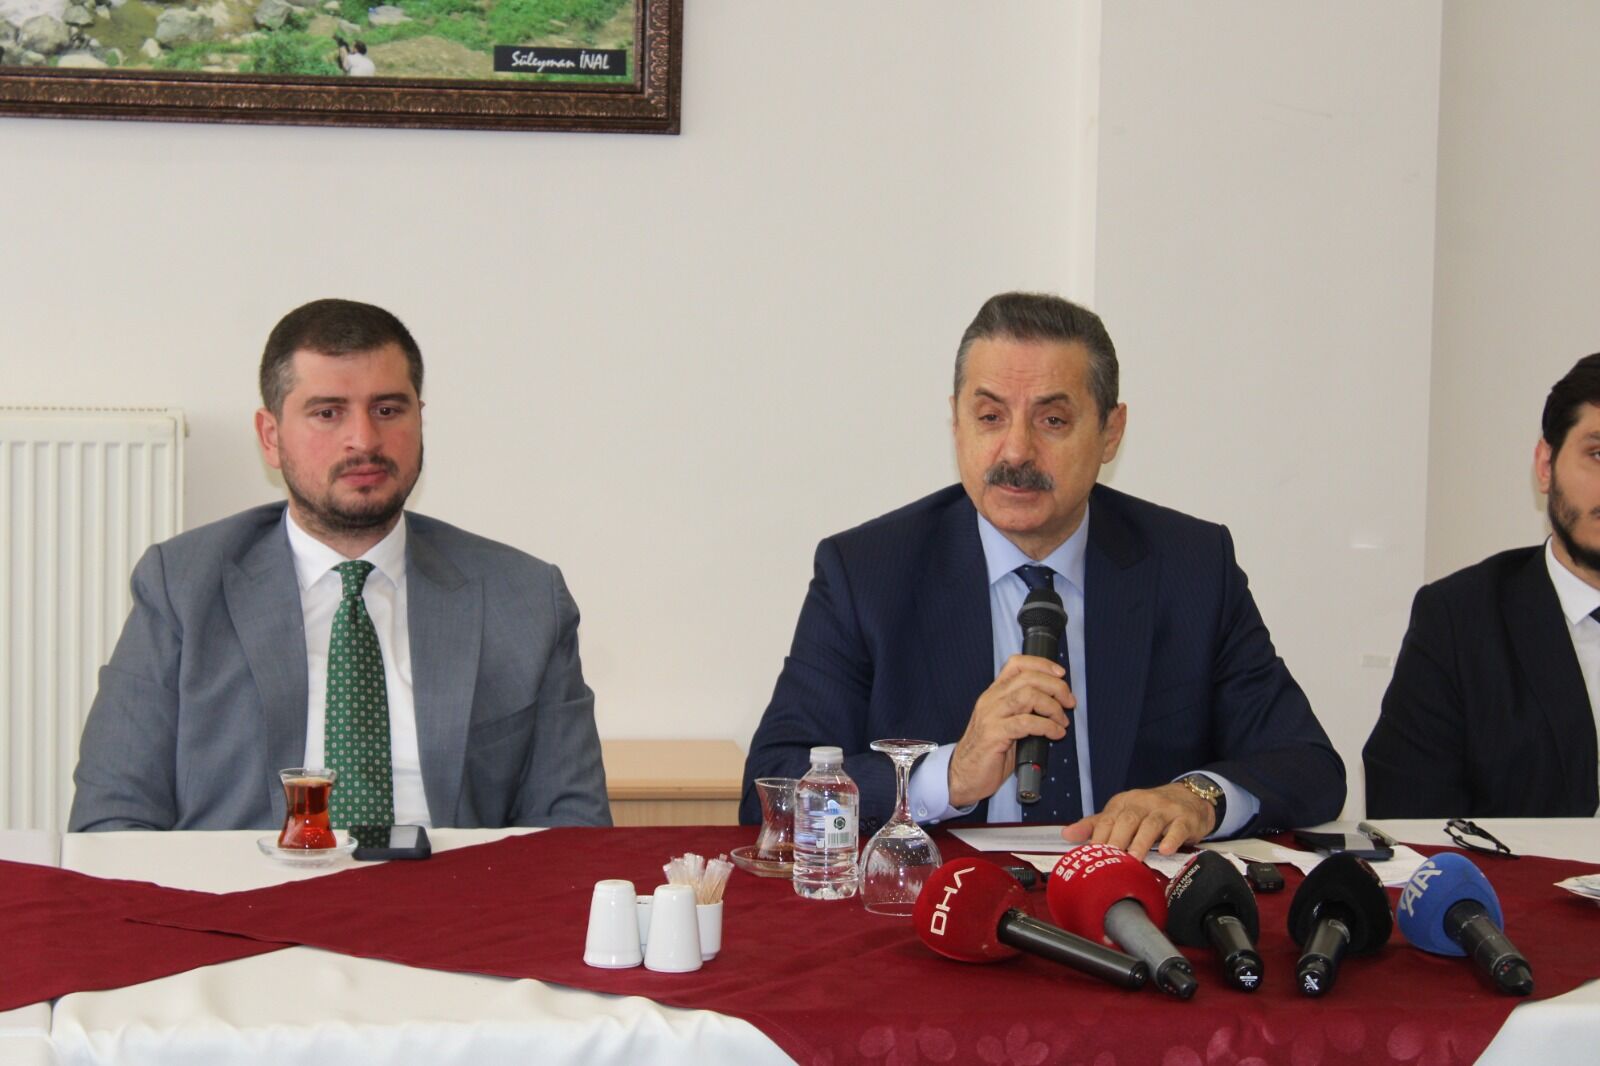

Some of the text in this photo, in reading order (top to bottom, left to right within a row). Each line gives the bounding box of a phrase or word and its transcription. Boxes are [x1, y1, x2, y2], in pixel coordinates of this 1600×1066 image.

[511, 50, 610, 72] Süleyman İNAL
[1082, 857, 1122, 879] .com
[930, 866, 976, 936] DHA
[1400, 860, 1443, 918] AA
